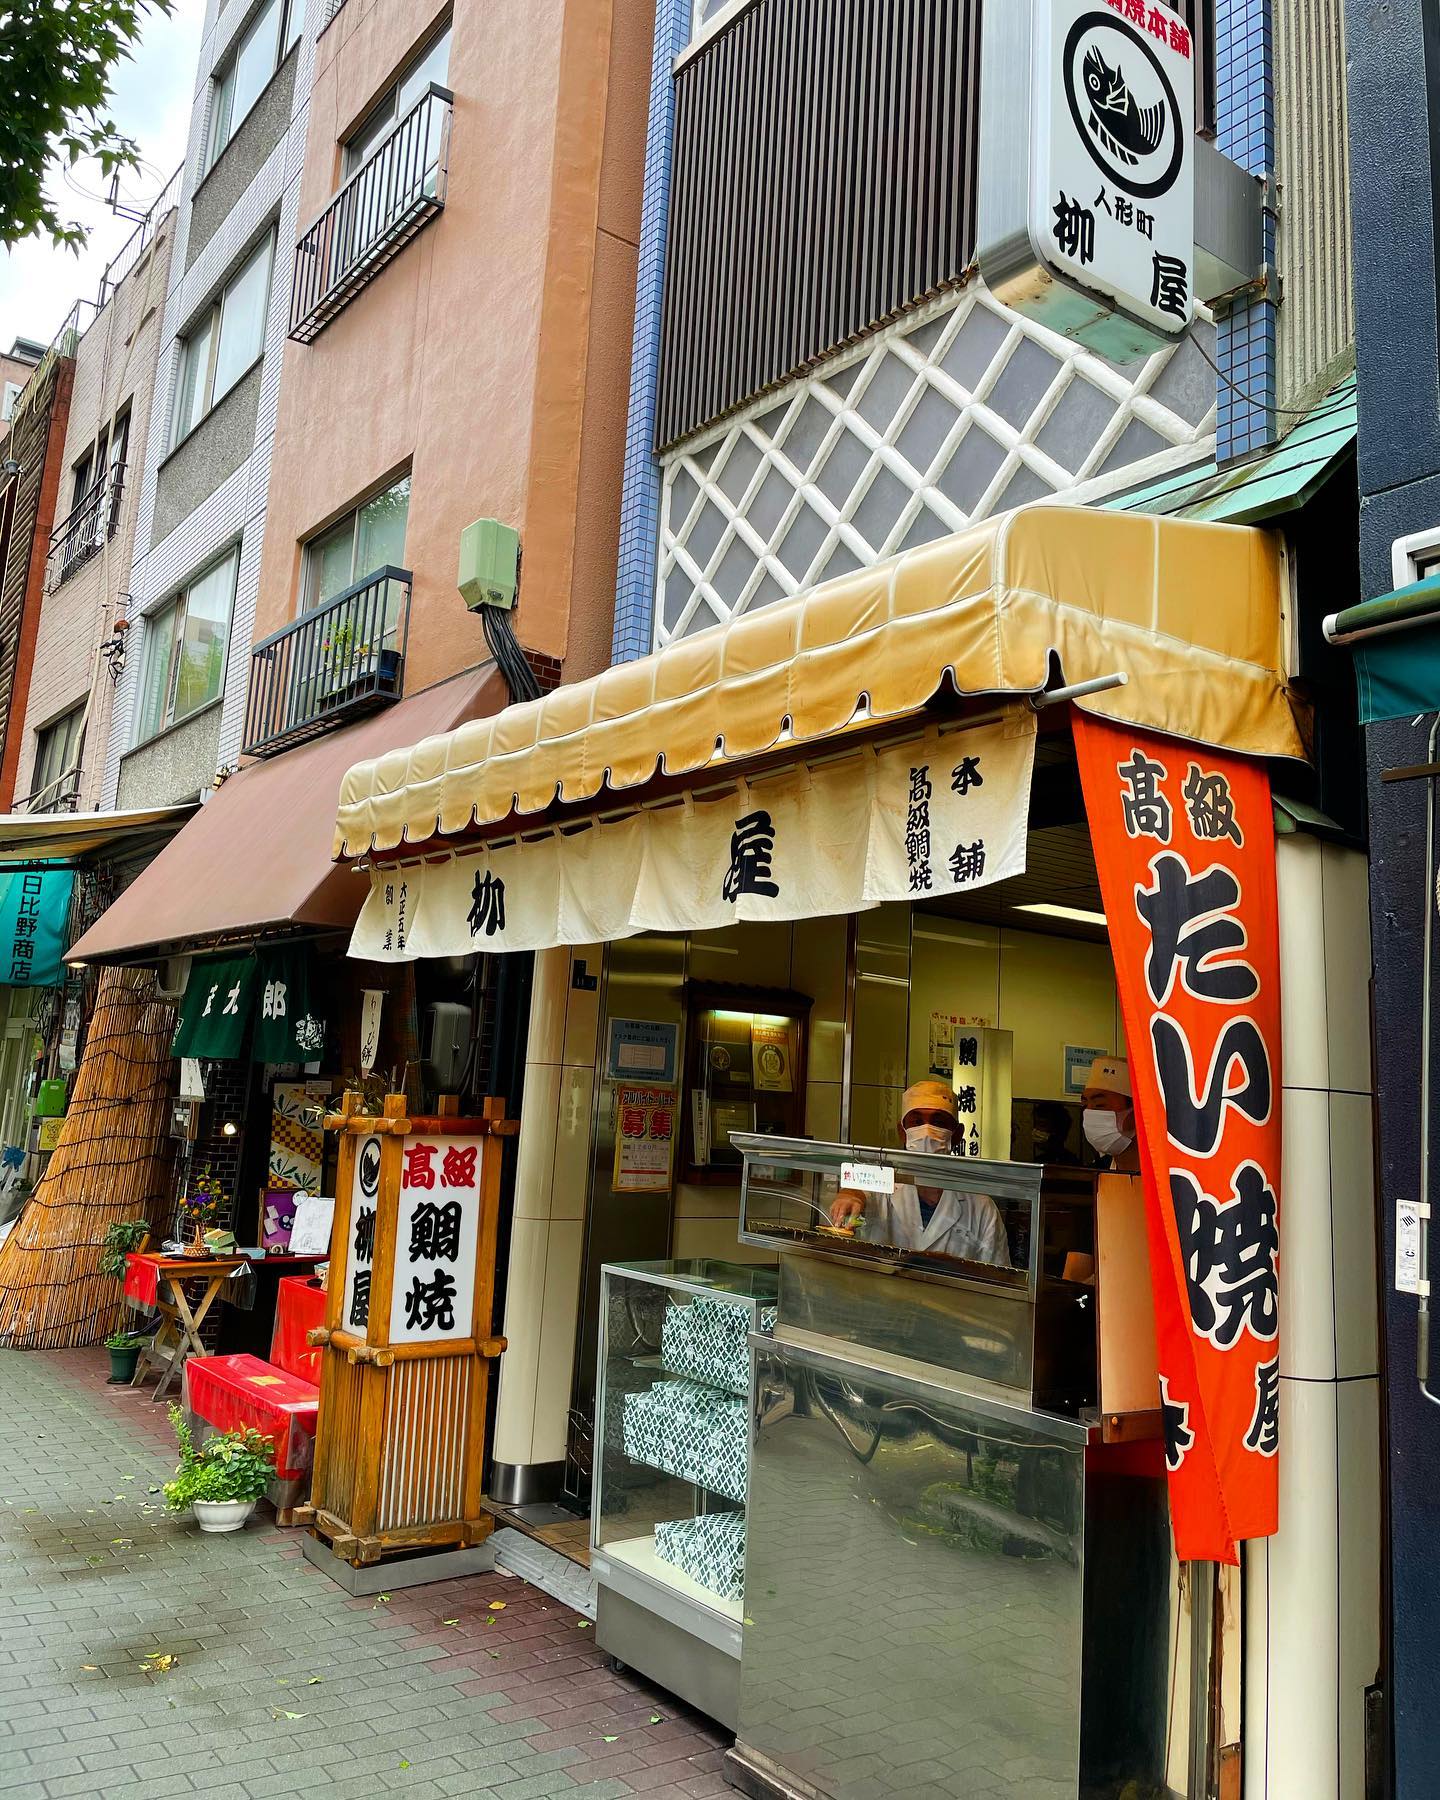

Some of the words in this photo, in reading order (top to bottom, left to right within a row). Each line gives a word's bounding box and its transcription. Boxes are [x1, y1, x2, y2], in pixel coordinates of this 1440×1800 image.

[1106, 0, 1189, 59] 焼本舗
[1094, 185, 1155, 241] 人形町
[382, 884, 394, 951] 創業
[397, 881, 408, 950] 大正五年
[958, 1037, 977, 1113] 鯛焼
[1135, 850, 1278, 1350] たい焼
[622, 1109, 673, 1138] 募集
[405, 1200, 463, 1331] 鯛焼
